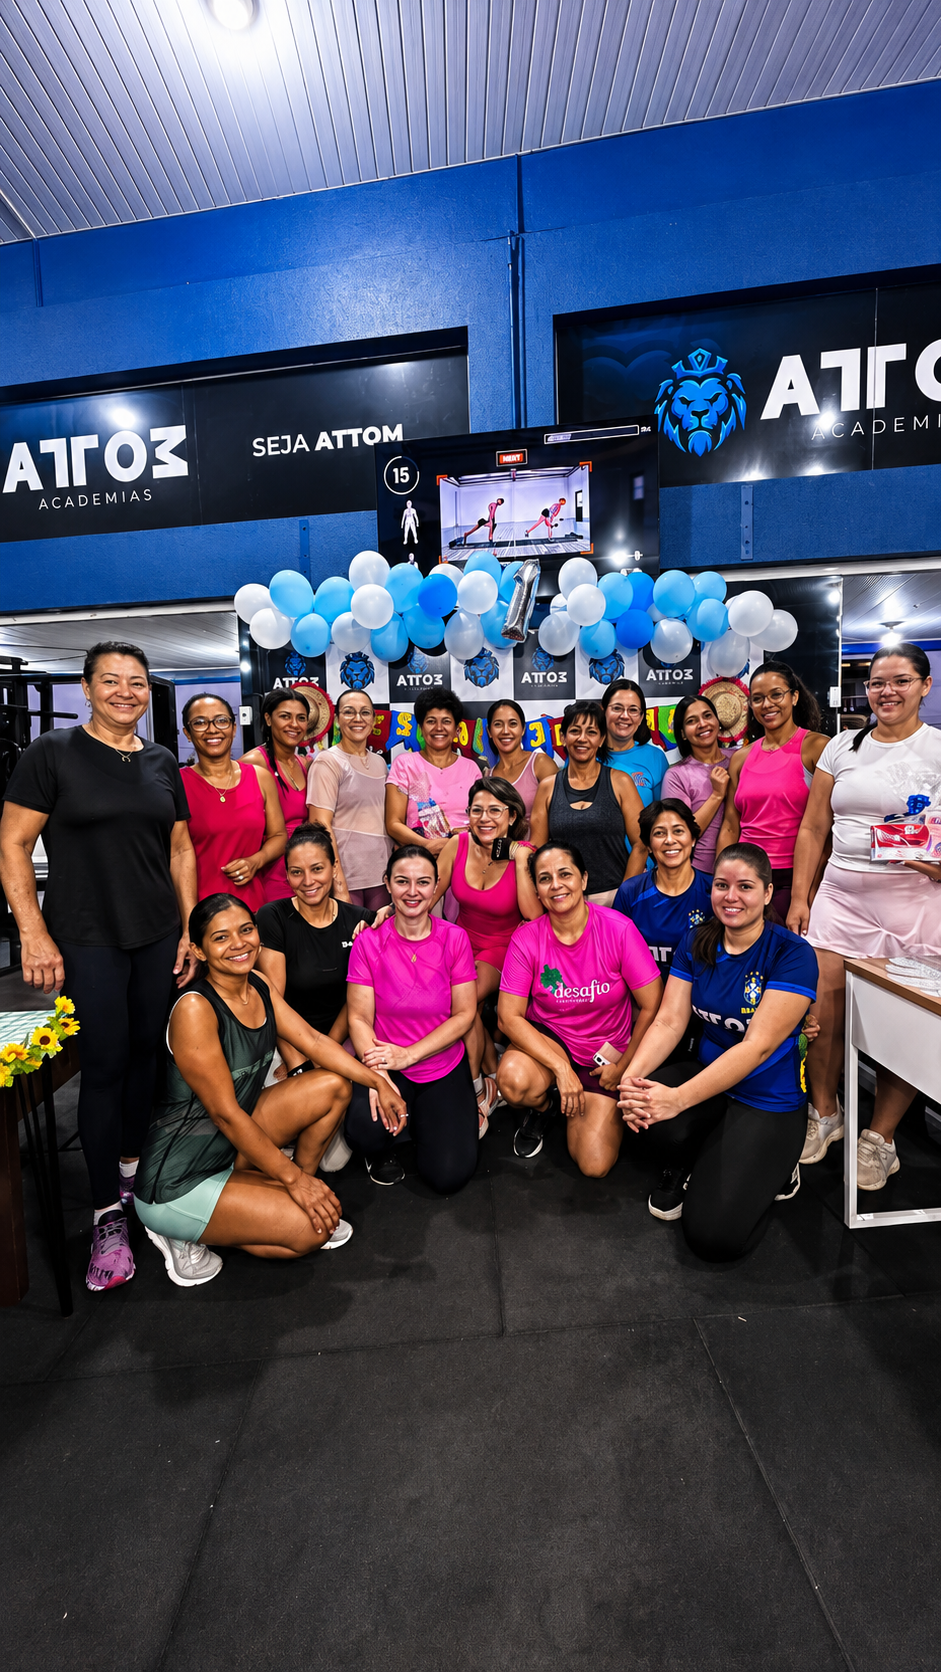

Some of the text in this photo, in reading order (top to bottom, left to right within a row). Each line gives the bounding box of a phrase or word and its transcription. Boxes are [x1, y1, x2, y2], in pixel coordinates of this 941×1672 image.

[252, 423, 404, 457] SEJA ATTOM
[393, 466, 410, 484] 15
[39, 488, 153, 511] ACADEMIAS
[554, 979, 610, 1003] desafio
